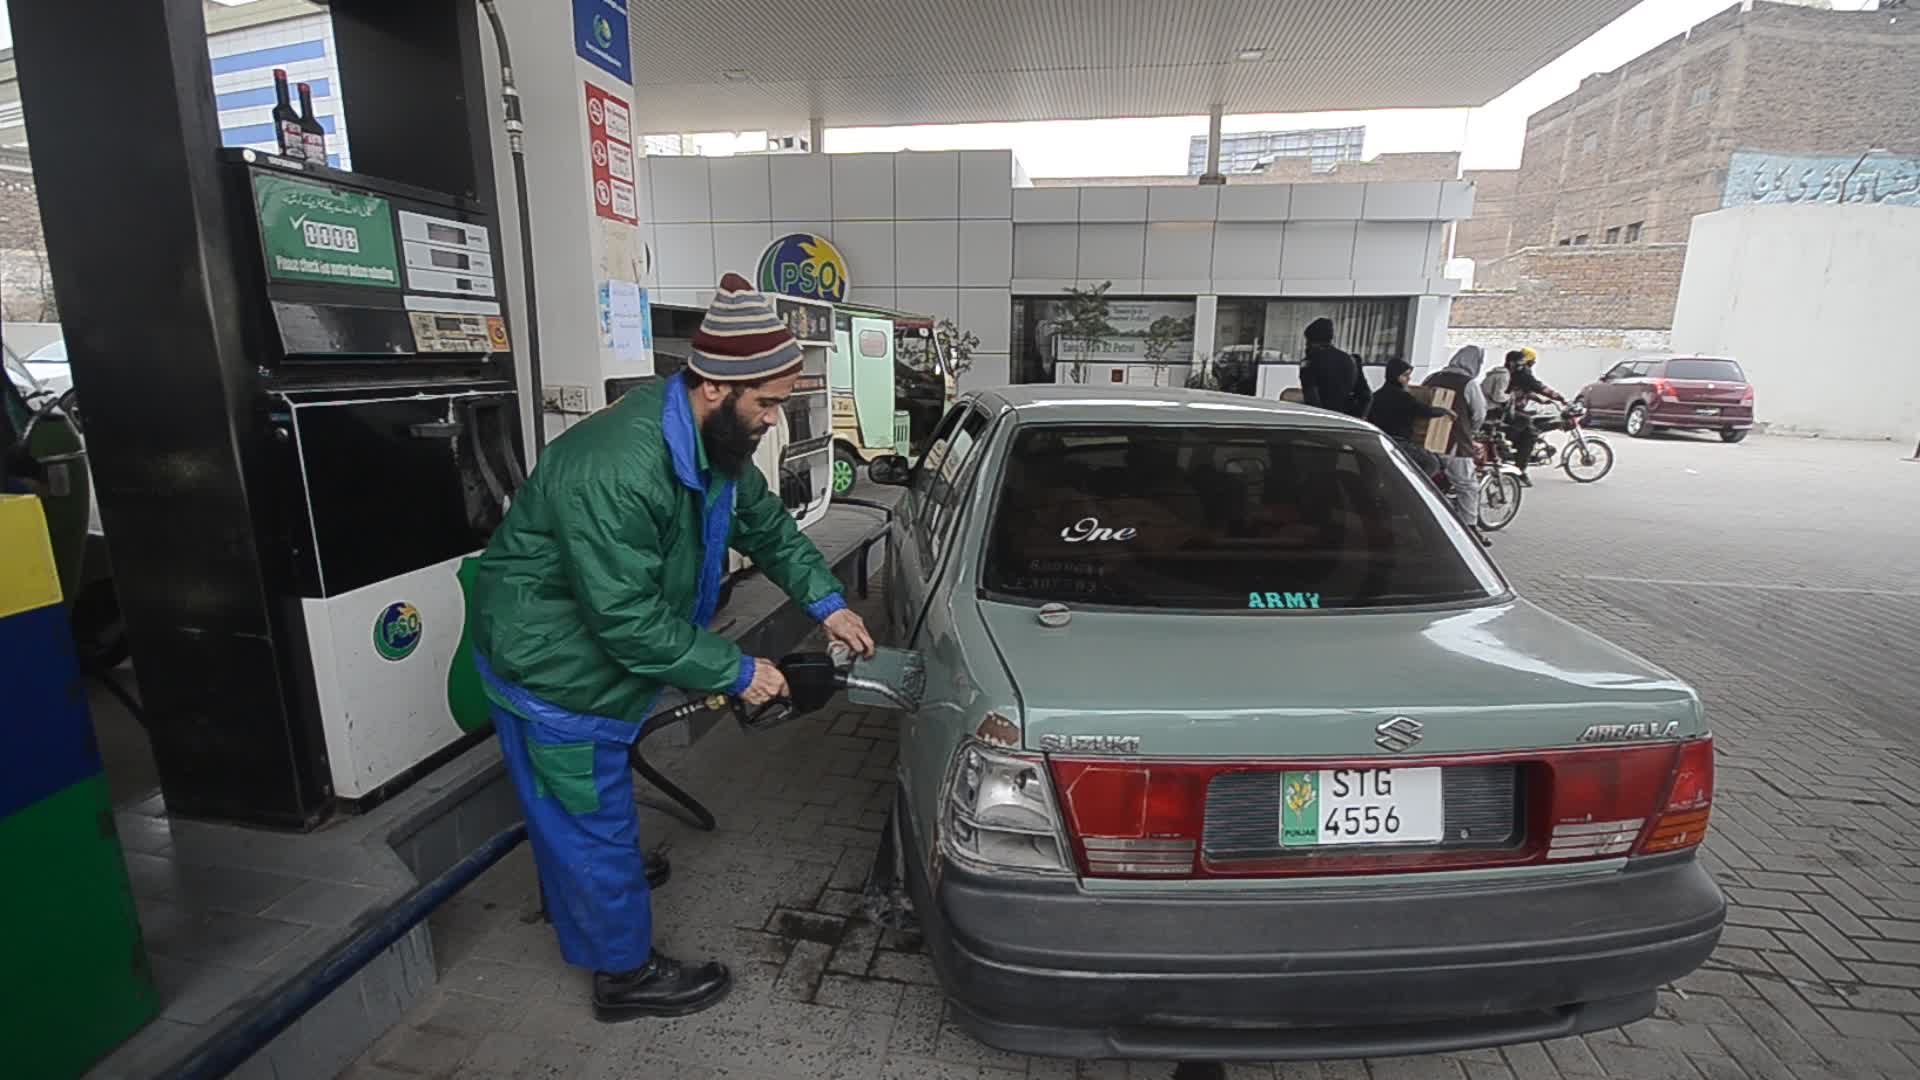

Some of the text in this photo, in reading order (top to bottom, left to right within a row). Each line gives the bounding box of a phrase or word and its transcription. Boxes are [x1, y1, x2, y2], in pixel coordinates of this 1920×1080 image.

[780, 261, 838, 294] PSO
[1060, 517, 1137, 543] One
[1248, 591, 1320, 609] ARMY
[387, 612, 419, 645] PSO
[1040, 733, 1140, 753] SUZUKI
[1332, 768, 1392, 798] STG
[1324, 805, 1401, 836] 4556
